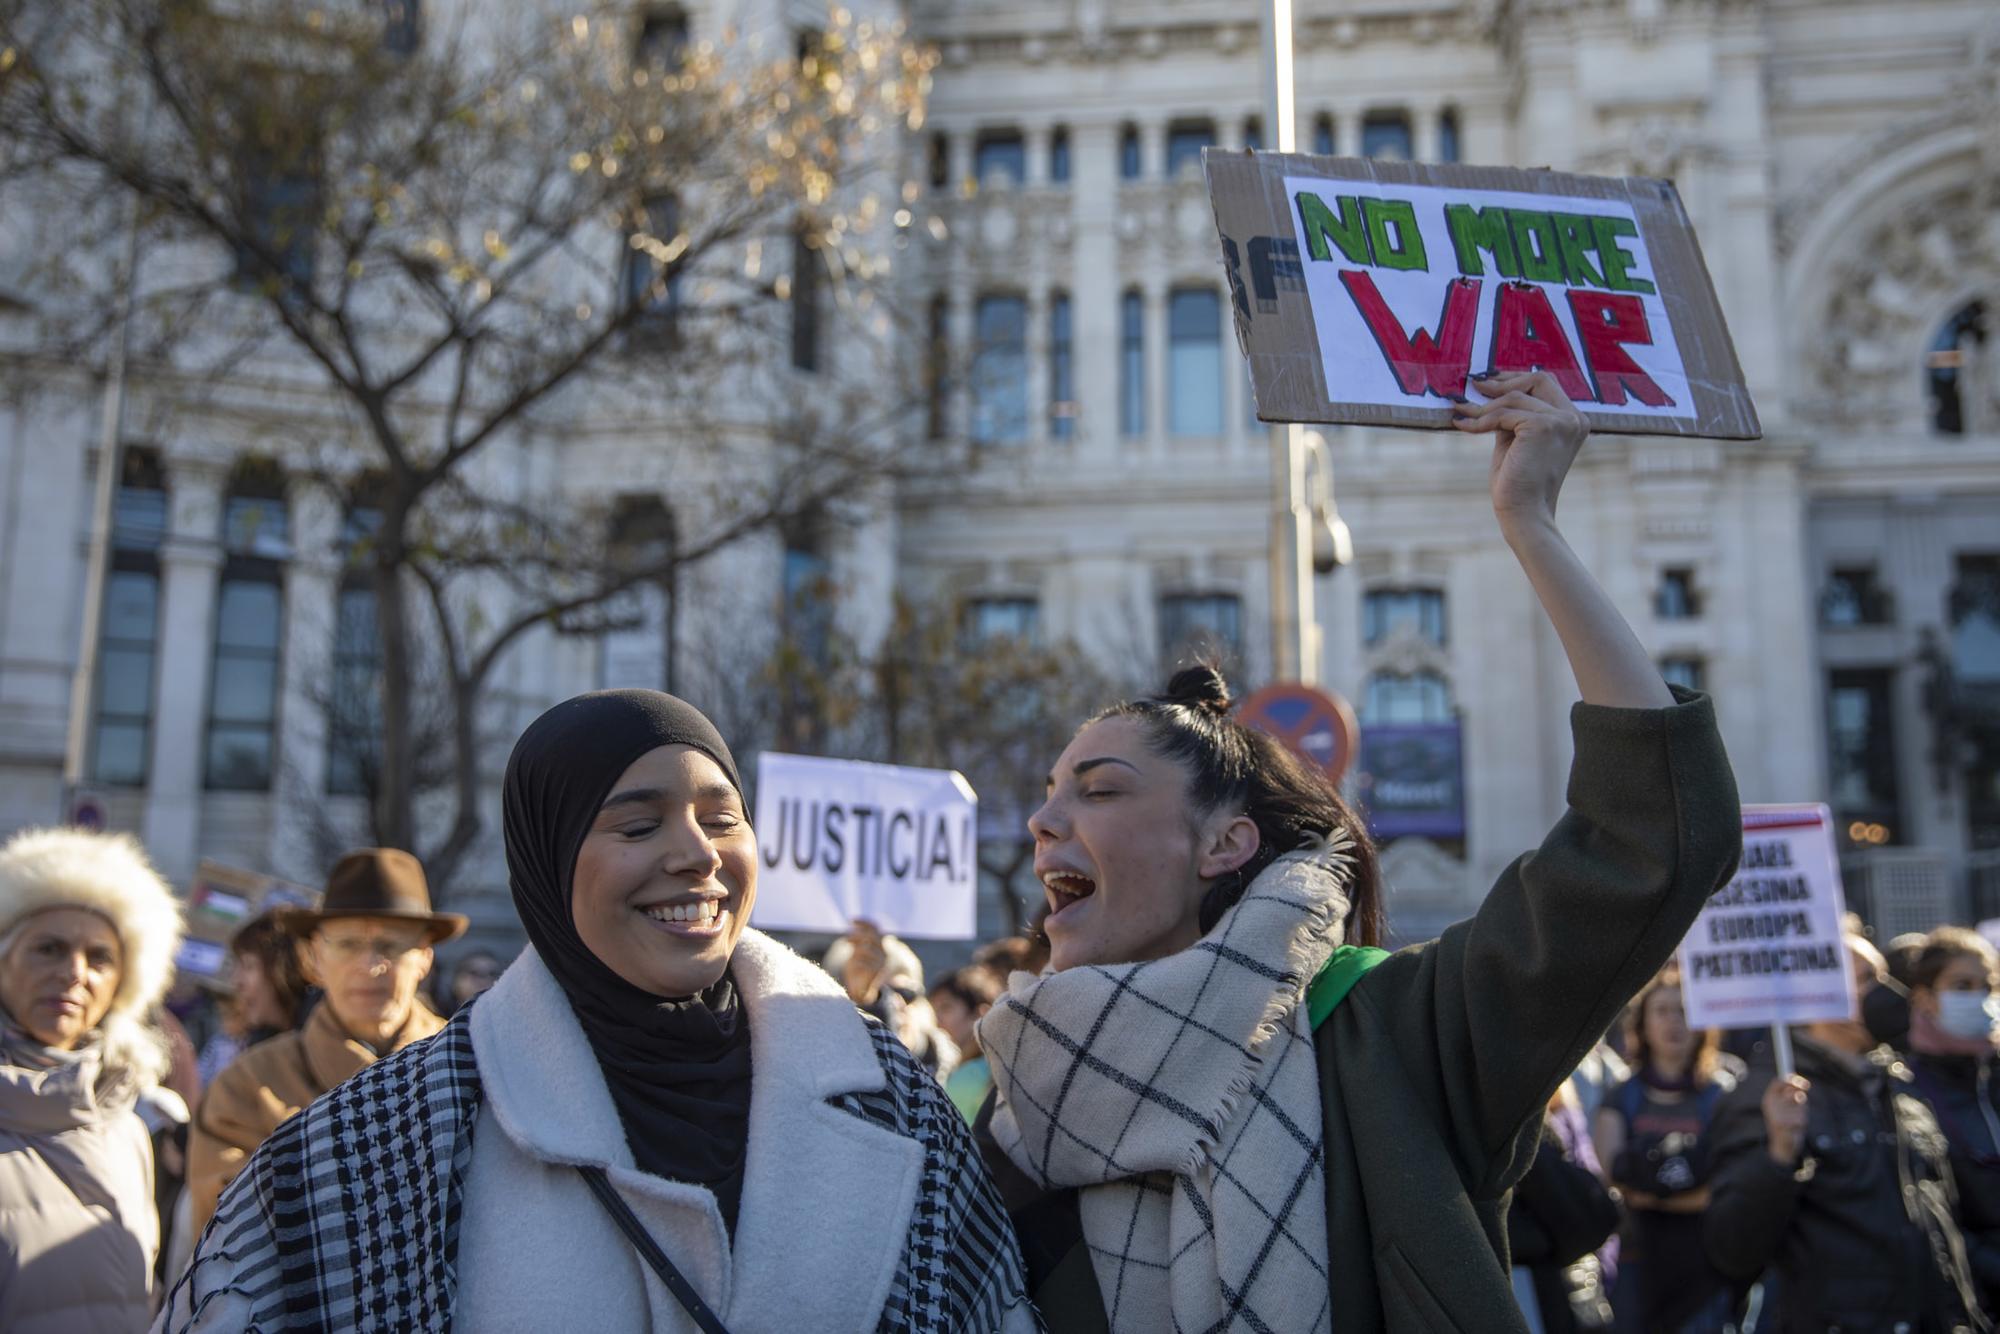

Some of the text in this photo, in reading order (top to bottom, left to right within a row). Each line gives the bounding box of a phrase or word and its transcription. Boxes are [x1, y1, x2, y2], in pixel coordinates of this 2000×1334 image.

[1294, 191, 1656, 295] NO MORE
[1338, 269, 1676, 407] WAR
[763, 798, 970, 883] JUSTICIA!
[1690, 943, 1840, 978] PATROCINA
[1708, 911, 1811, 942] EUROPA
